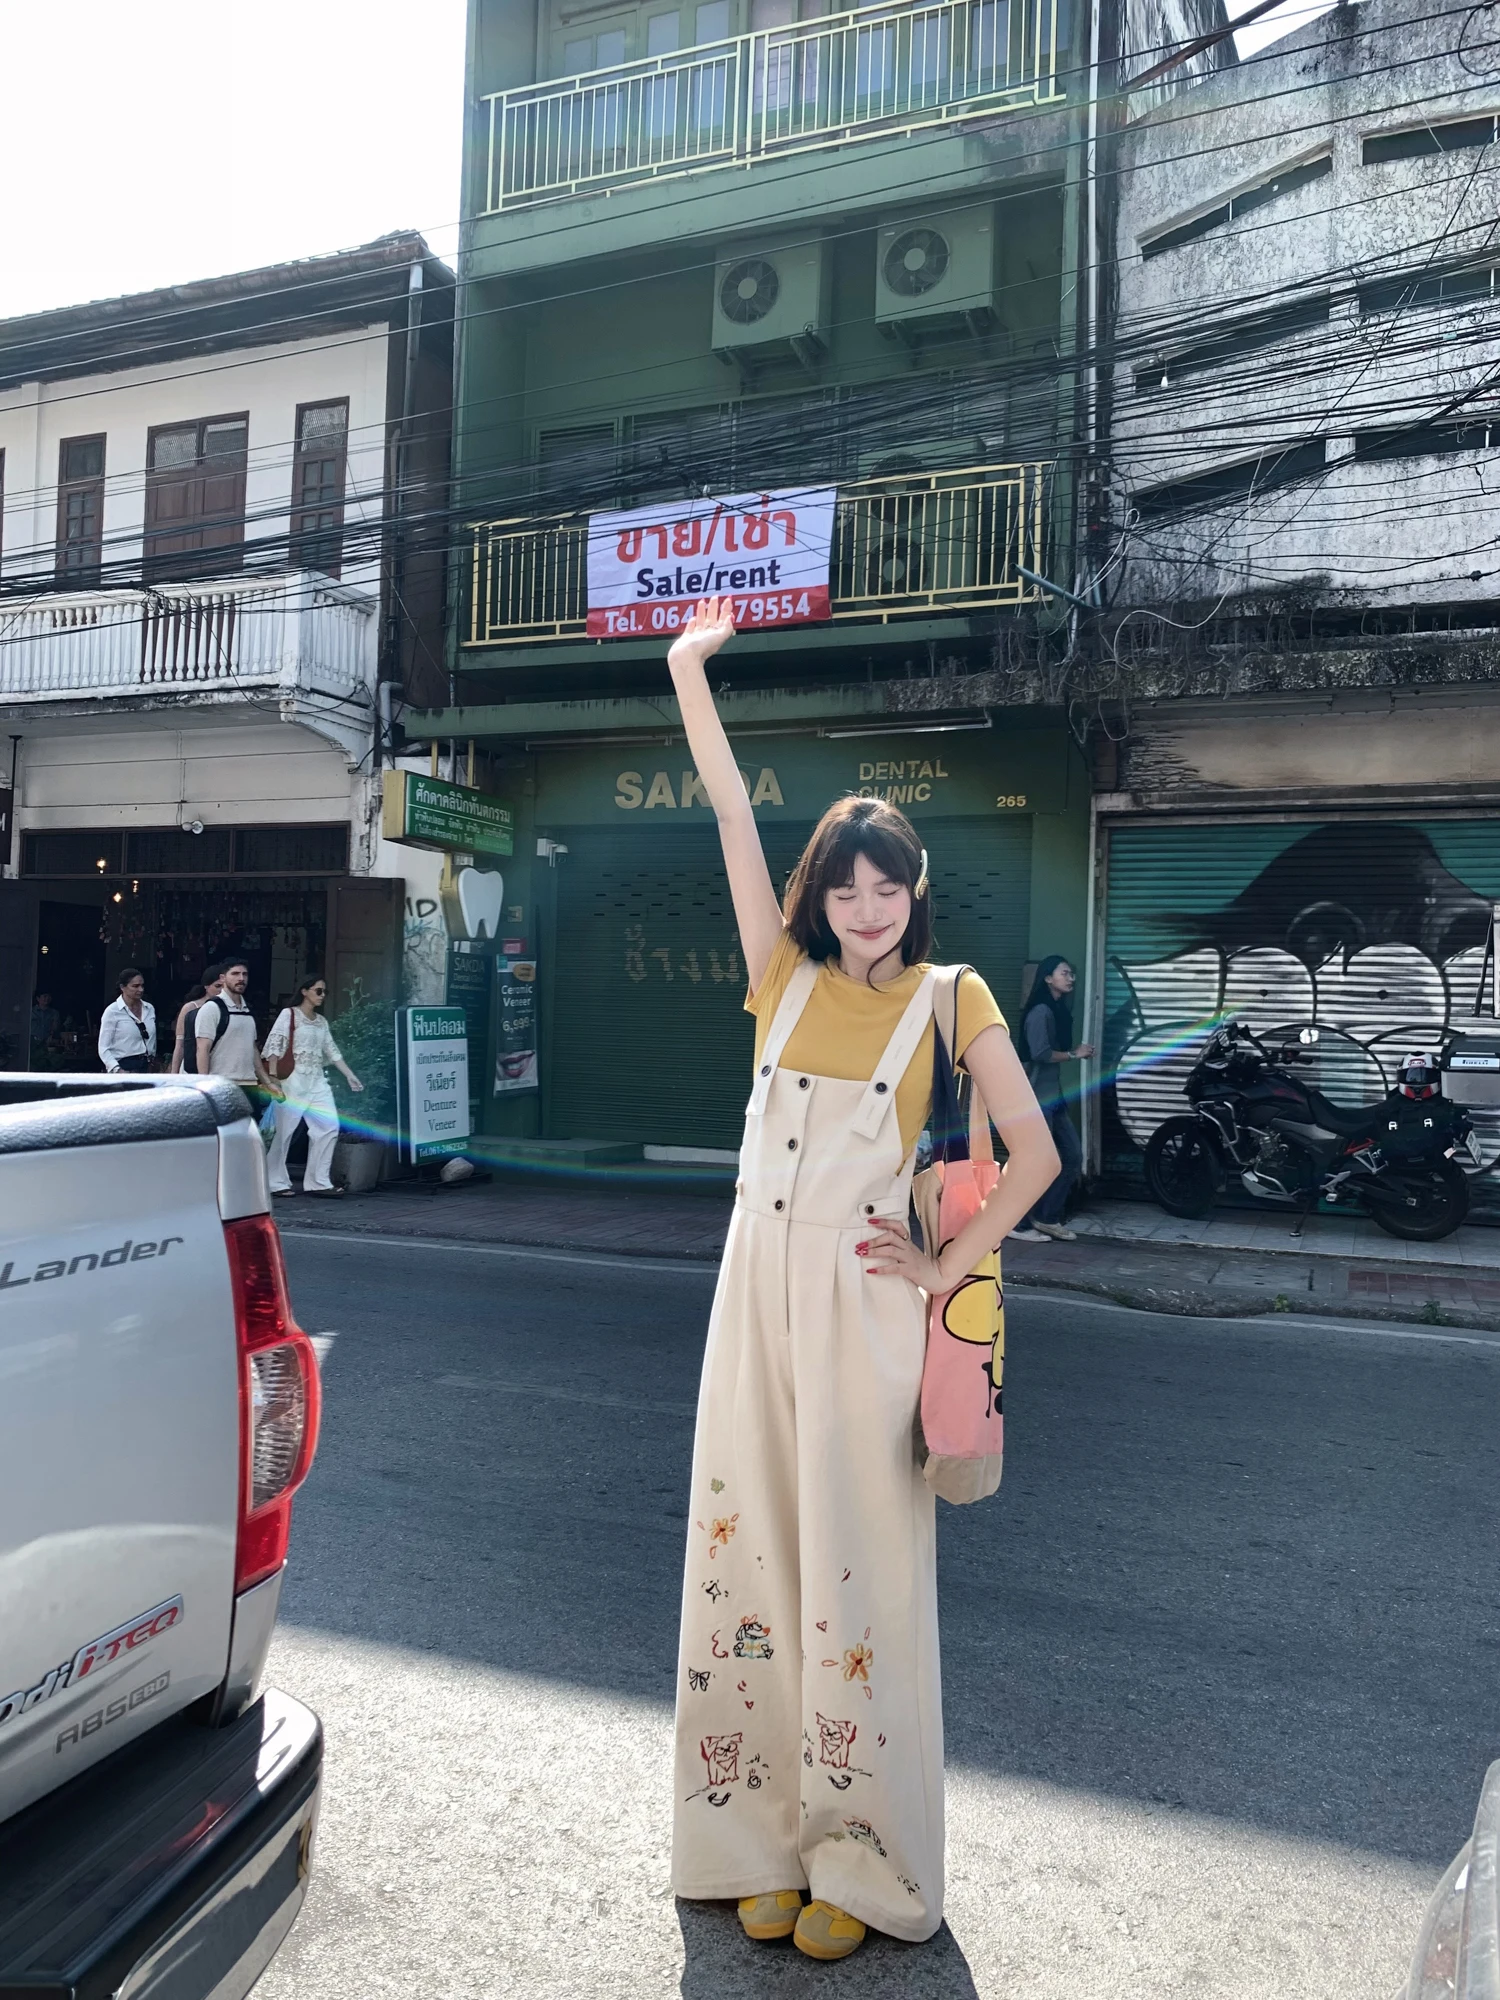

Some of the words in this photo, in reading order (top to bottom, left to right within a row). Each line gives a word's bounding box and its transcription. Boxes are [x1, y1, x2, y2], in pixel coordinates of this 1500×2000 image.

[617, 494, 797, 563] ขาย/เช่า
[636, 559, 781, 598] Sale/rent
[605, 611, 643, 633] Tel.
[859, 759, 949, 781] DENTAL
[415, 782, 511, 822] ศักดาคลินิกทันตกรรม
[860, 783, 932, 805] CLINIC
[996, 795, 1027, 808] 265
[502, 997, 532, 1007] Veneer
[413, 1014, 466, 1037] ฟันปลอม
[426, 1070, 457, 1092] วีเนียร์
[423, 1099, 457, 1113] Denture
[428, 1118, 457, 1132] Veneer
[0, 1237, 184, 1290] Lander
[56, 1695, 127, 1754] ABS
[130, 1672, 170, 1707] EBD
